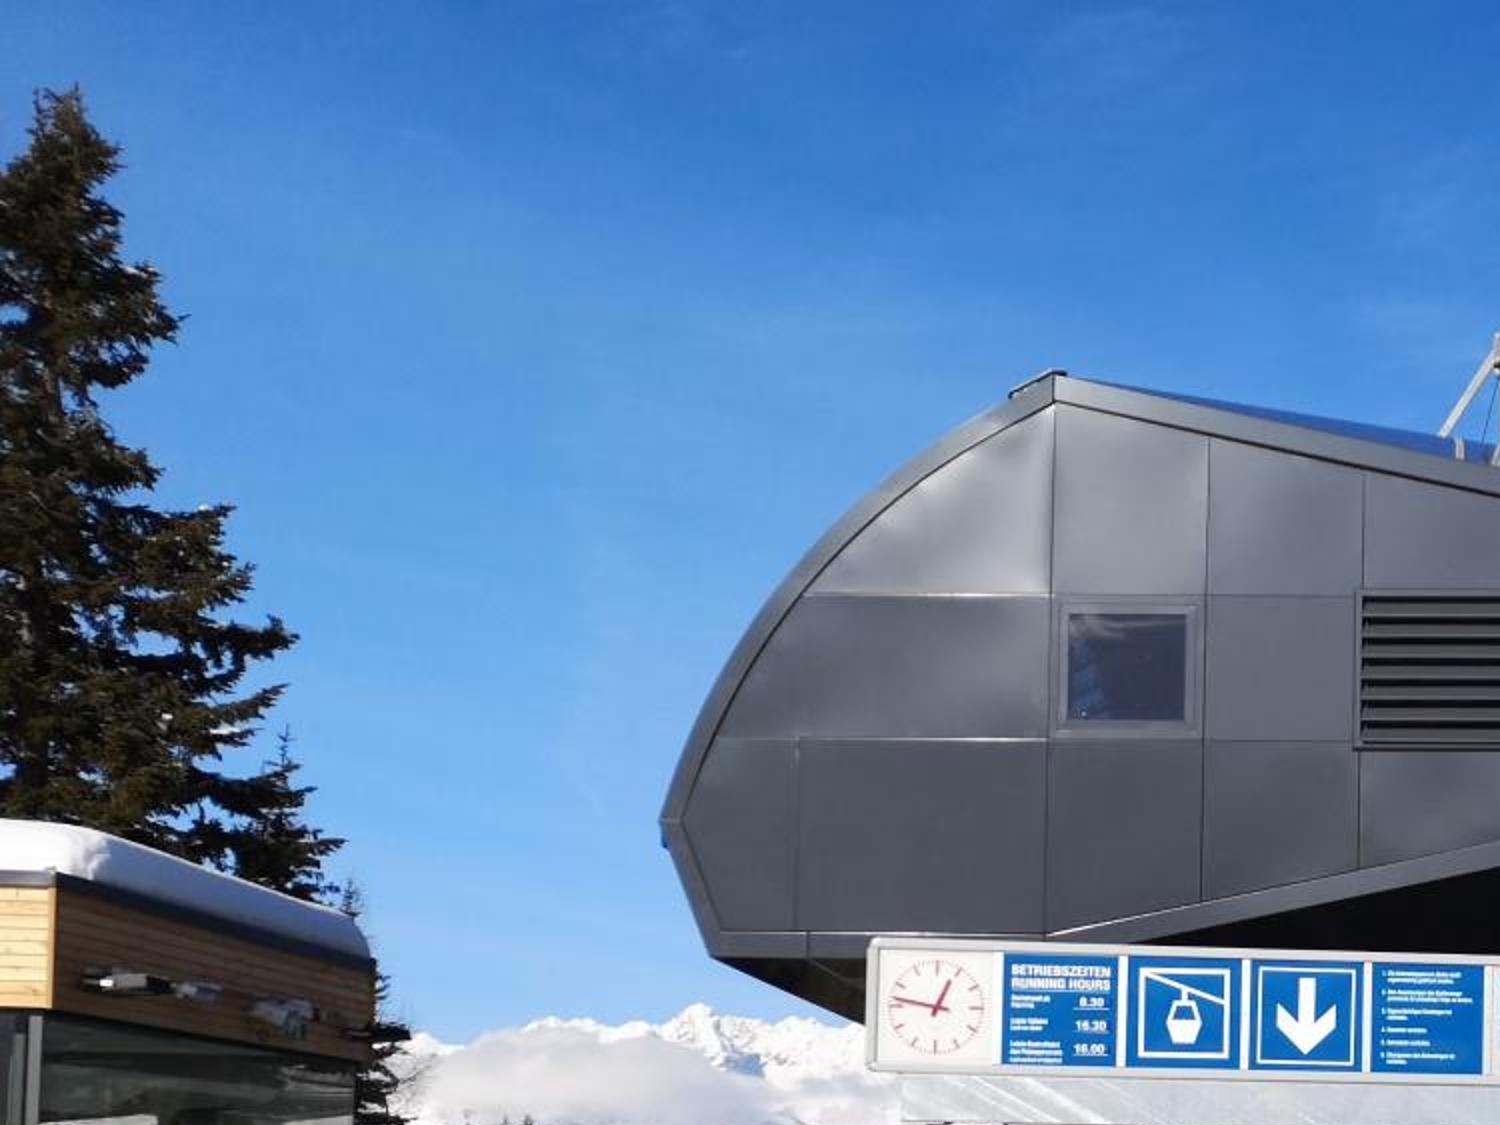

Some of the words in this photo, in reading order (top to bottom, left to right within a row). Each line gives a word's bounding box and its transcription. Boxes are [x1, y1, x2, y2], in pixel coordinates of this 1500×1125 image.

[1011, 963, 1111, 977] BETRIEBSZEITEN
[1011, 977, 1066, 990] RUNNING
[1069, 978, 1111, 991] HOURS
